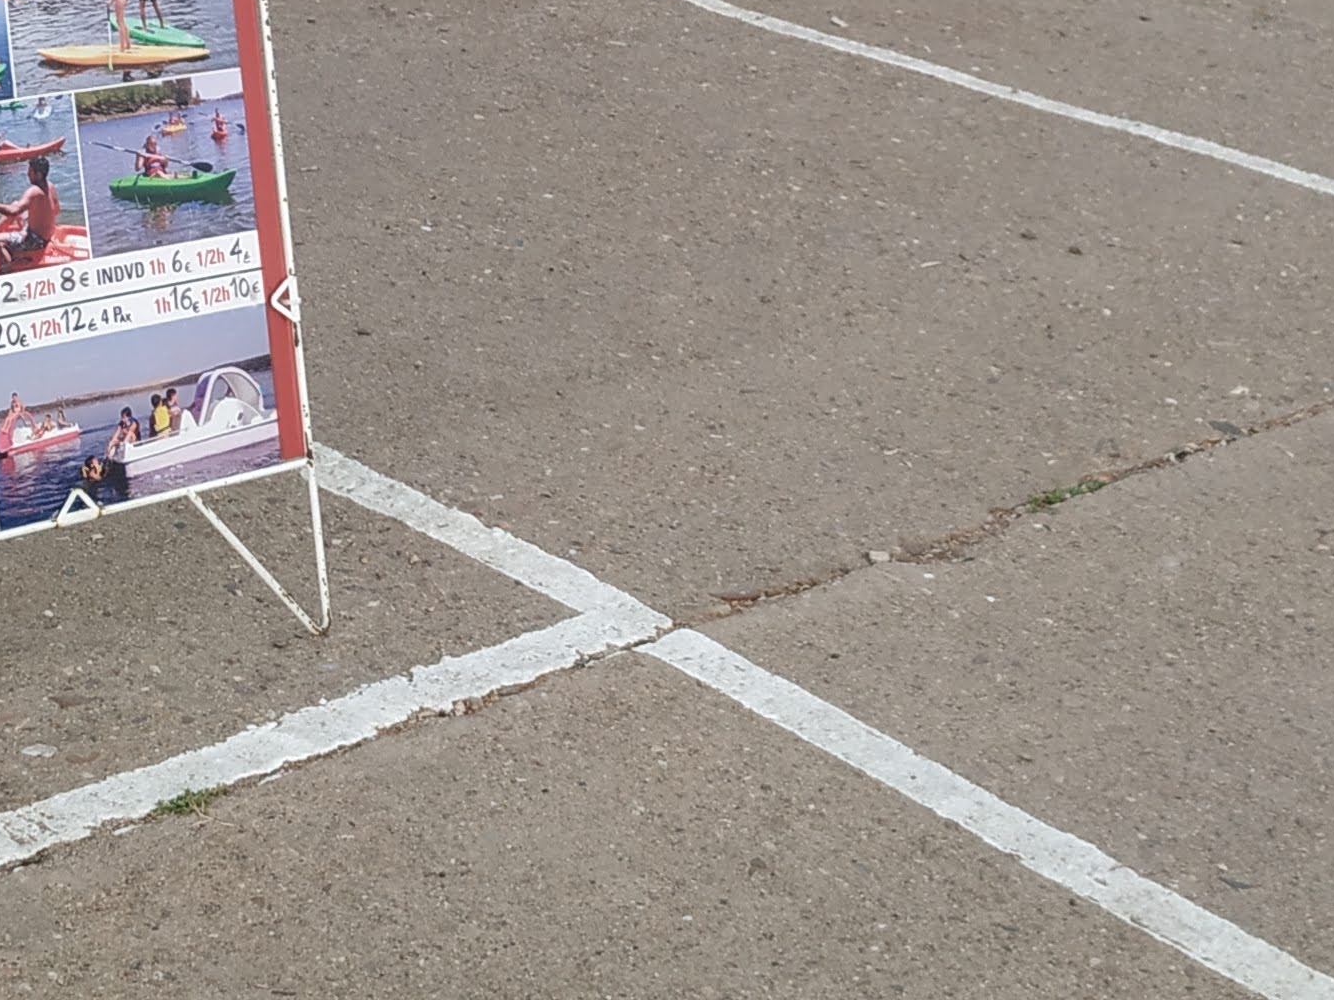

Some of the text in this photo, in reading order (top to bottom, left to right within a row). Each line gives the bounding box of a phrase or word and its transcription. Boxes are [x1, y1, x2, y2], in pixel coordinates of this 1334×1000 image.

[25, 278, 56, 300] 1/2h
[96, 261, 145, 285] INDVD
[149, 258, 166, 275] 1h
[196, 249, 225, 268] 1/2h
[30, 318, 61, 340] 1/2h
[101, 311, 109, 324] 4
[154, 298, 171, 315] 1h
[202, 286, 230, 306] 1/2h
